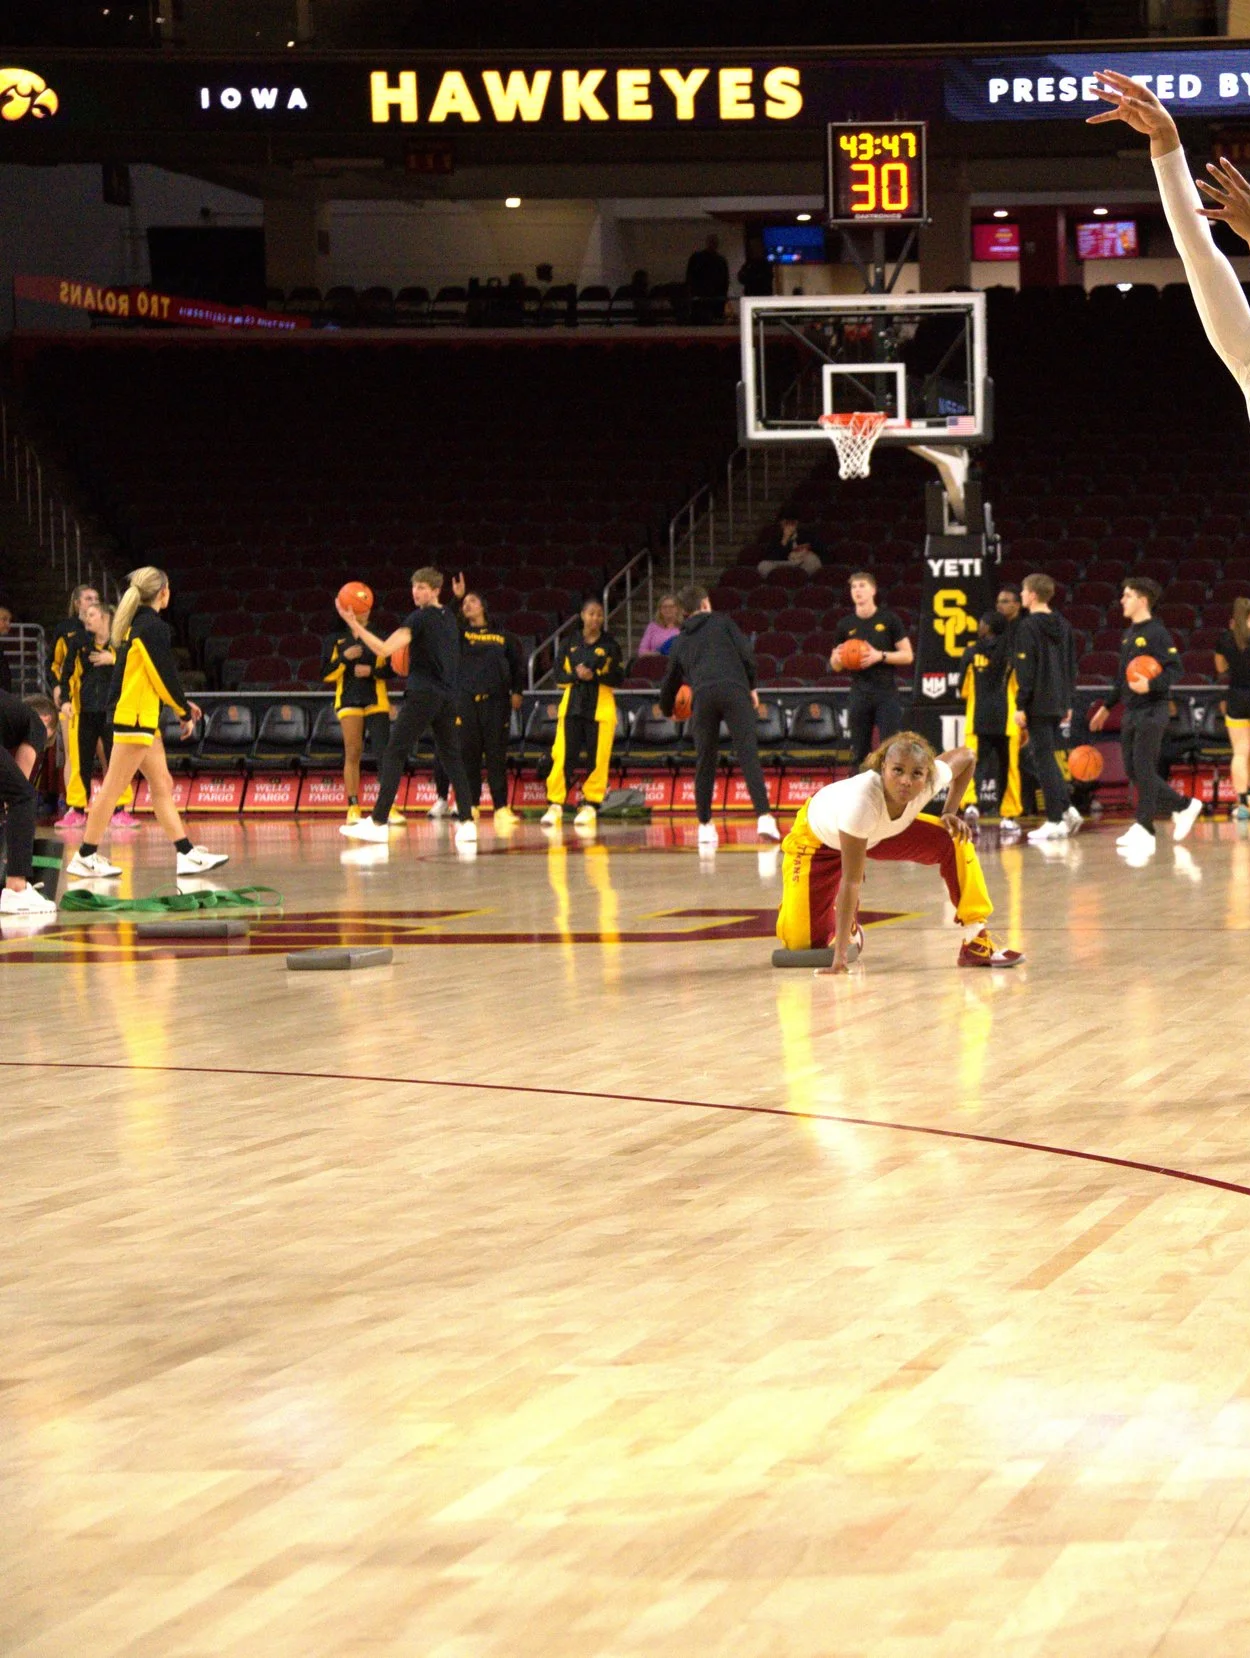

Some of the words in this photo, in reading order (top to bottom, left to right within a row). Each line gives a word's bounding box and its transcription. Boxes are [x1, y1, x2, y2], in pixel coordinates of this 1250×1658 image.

[201, 88, 308, 110] IOWA
[370, 67, 804, 123] HAWKEYES
[989, 74, 1202, 102] PRESEED
[839, 132, 917, 160] 43:47
[850, 162, 909, 212] 30
[927, 558, 982, 577] YETI
[933, 588, 978, 657] SC
